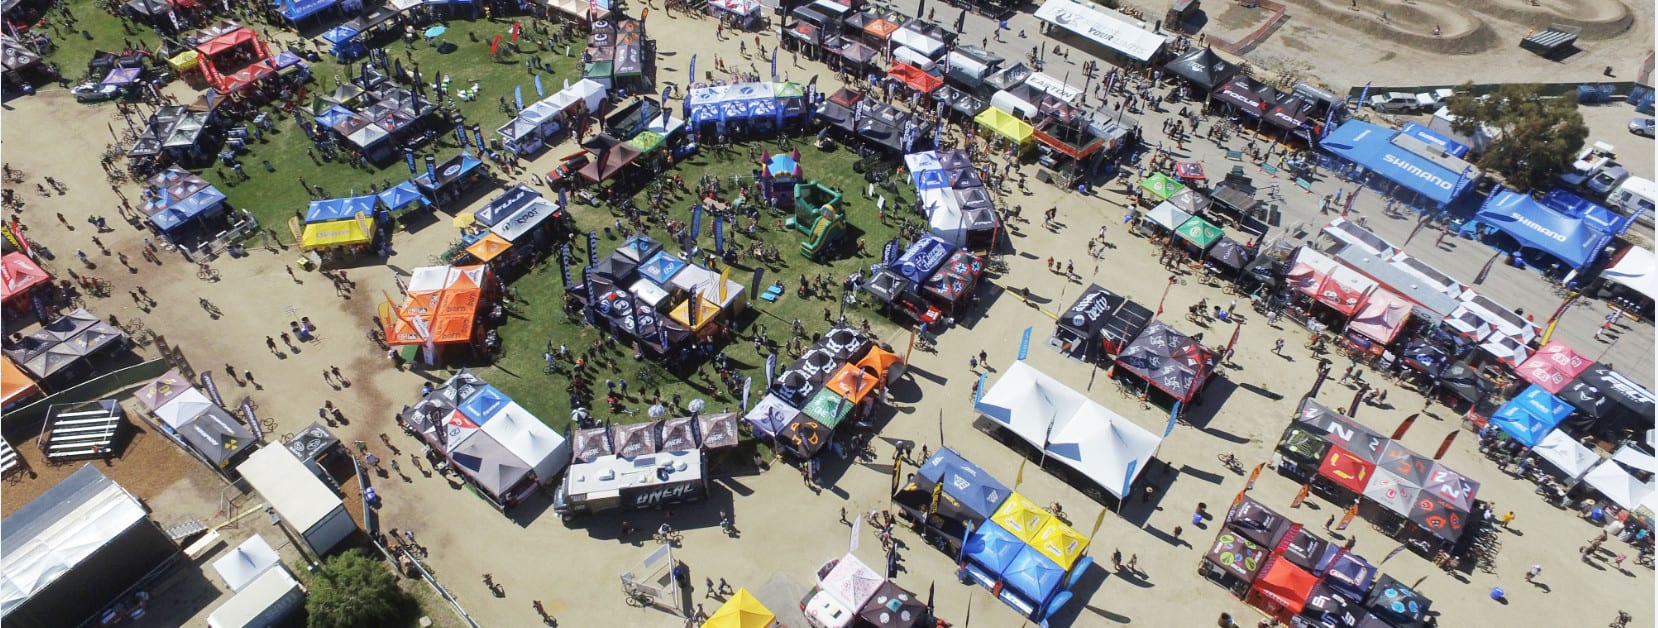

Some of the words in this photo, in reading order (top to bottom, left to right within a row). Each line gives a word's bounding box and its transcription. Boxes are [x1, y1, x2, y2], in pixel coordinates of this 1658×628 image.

[1089, 27, 1114, 42] YOUR
[1223, 89, 1259, 108] FOCUS
[1383, 153, 1452, 190] SHIMANO
[494, 191, 525, 215] FUJI
[517, 206, 538, 226] SPOT
[1511, 212, 1567, 243] SHIMANO
